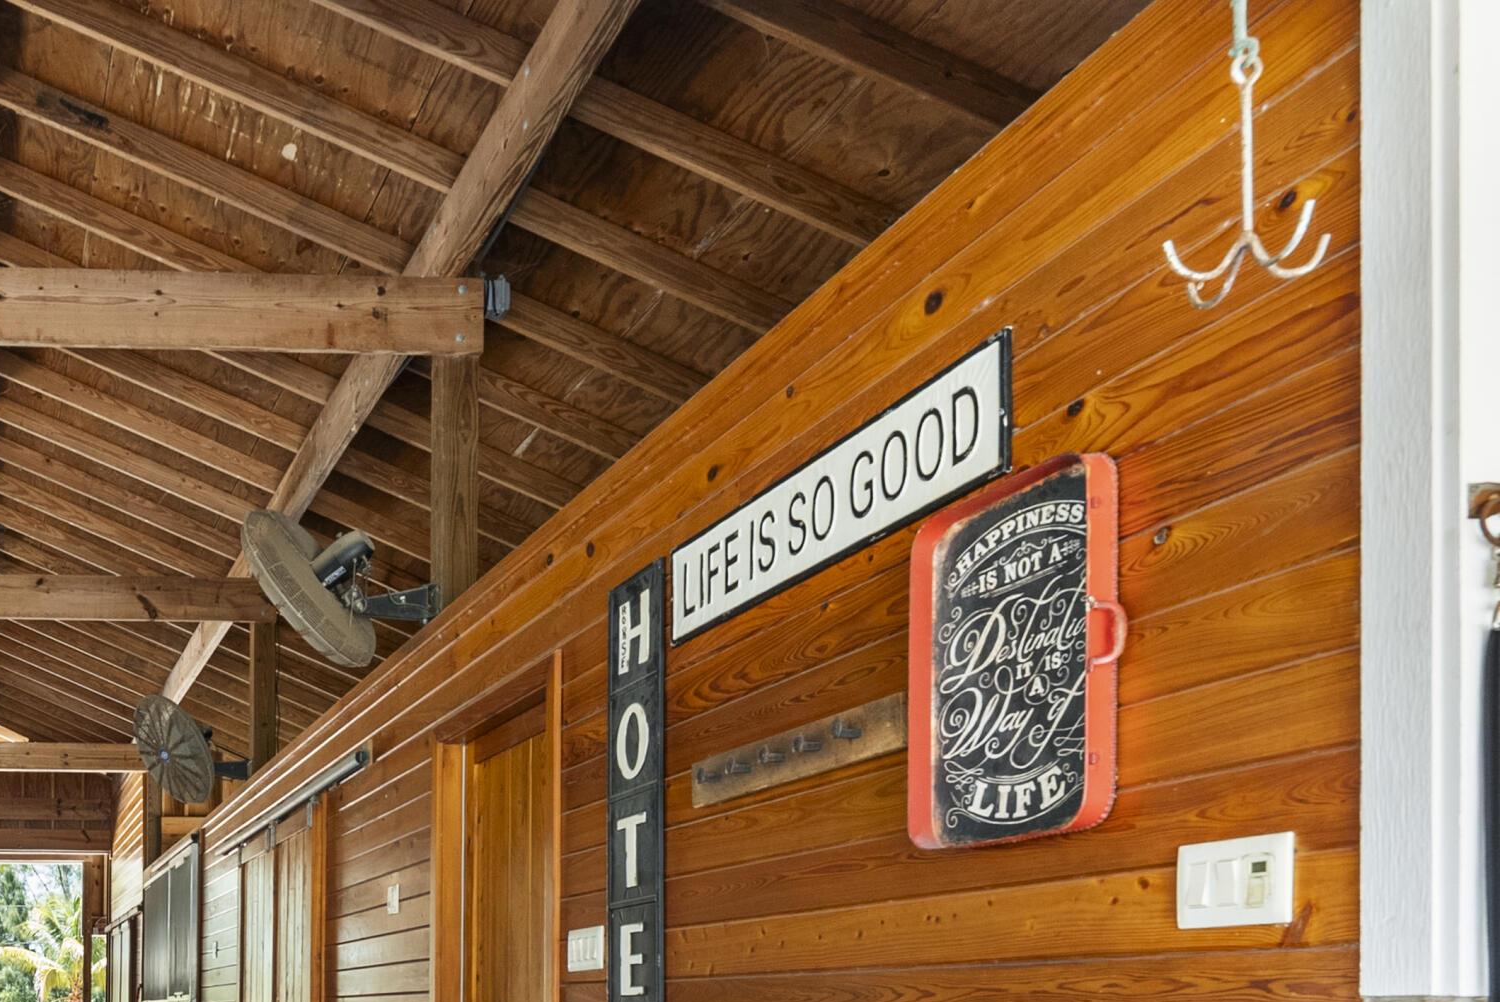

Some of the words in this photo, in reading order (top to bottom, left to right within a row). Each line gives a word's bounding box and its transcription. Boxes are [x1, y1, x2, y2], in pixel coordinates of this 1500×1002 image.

[683, 529, 739, 617] LIFE
[749, 511, 775, 580] IS
[788, 475, 834, 555] SO
[850, 386, 979, 518] GOOD
[956, 503, 1085, 576] HAPPINESS
[978, 570, 997, 593] IS
[1004, 551, 1042, 583] NOT
[1048, 542, 1062, 564] A
[940, 573, 1086, 693] Destinatio
[1015, 660, 1033, 680] IT
[1043, 651, 1062, 671] IS
[1029, 676, 1045, 697] A
[940, 665, 1035, 759] Way
[967, 765, 1066, 819] LIFE
